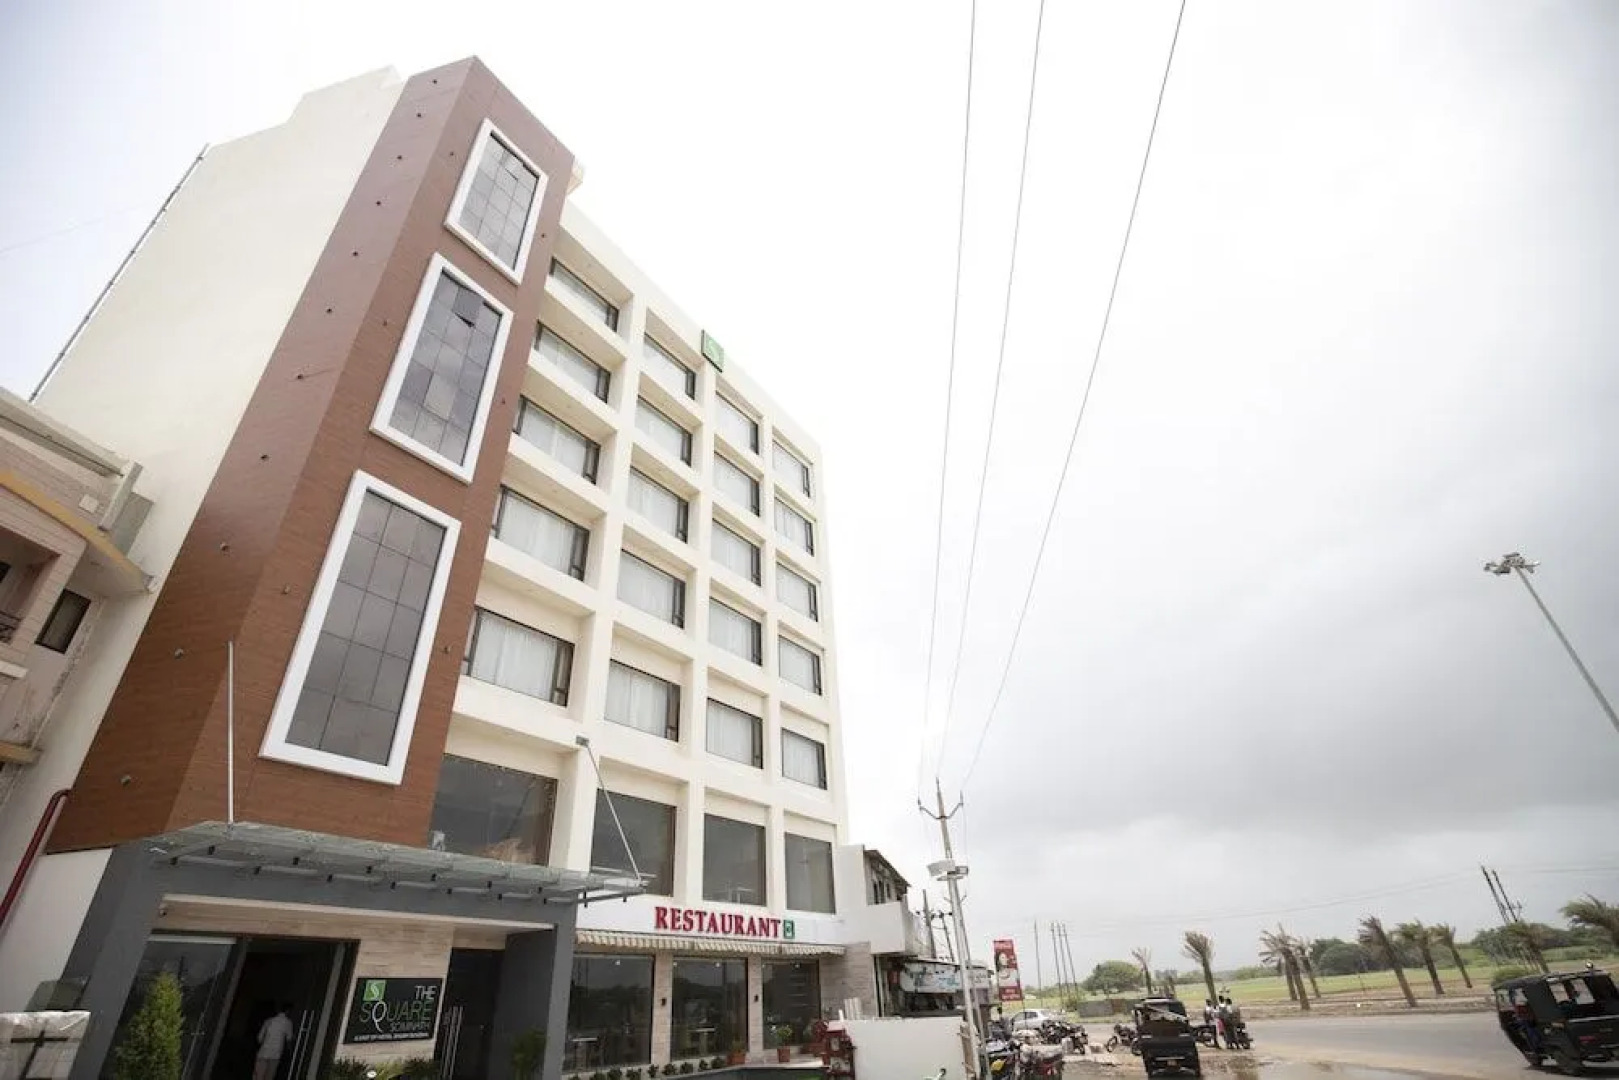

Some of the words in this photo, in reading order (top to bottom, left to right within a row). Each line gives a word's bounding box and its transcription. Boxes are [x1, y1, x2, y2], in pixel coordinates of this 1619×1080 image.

[654, 906, 781, 939] RESTAURANT
[414, 985, 437, 1000] THE
[359, 1000, 433, 1033] SQUARE
